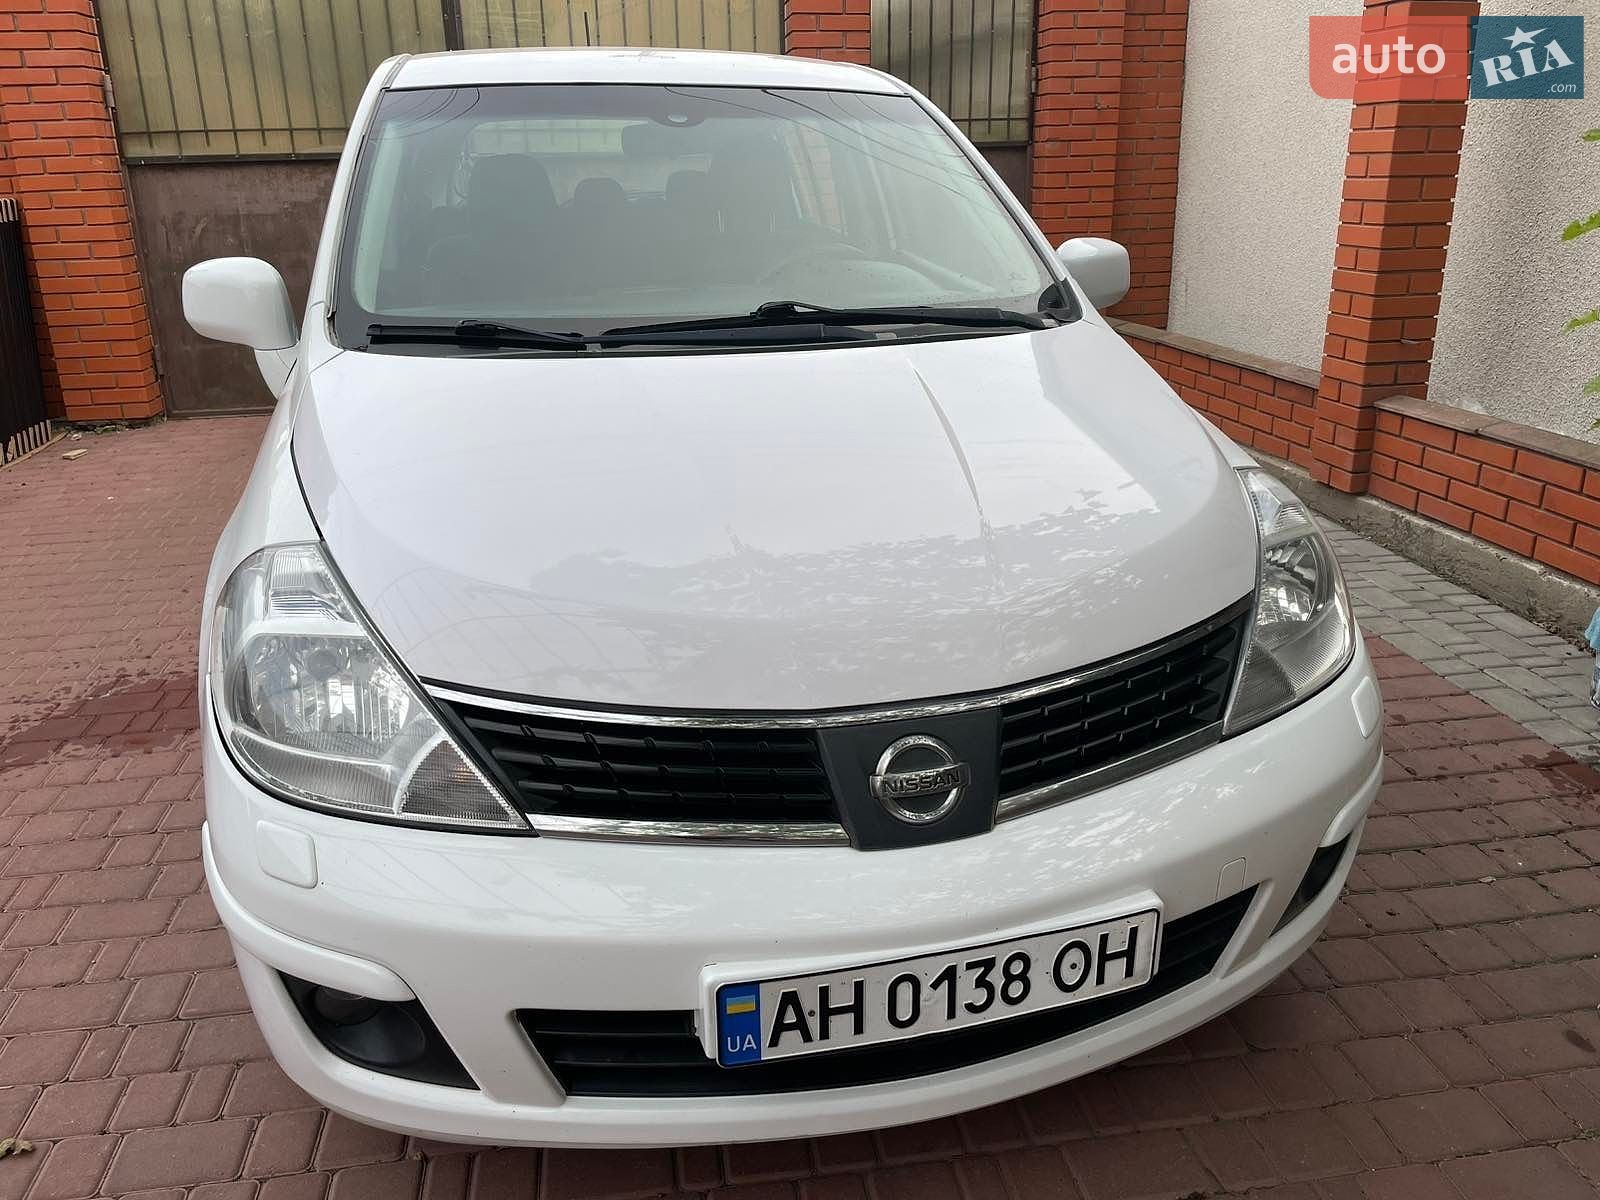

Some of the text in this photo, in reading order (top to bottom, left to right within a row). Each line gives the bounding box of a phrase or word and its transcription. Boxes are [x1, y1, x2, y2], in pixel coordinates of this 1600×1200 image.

[884, 771, 960, 793] NISSAN
[767, 925, 1139, 1048] AH 0138 OH
[726, 1033, 757, 1053] UA
